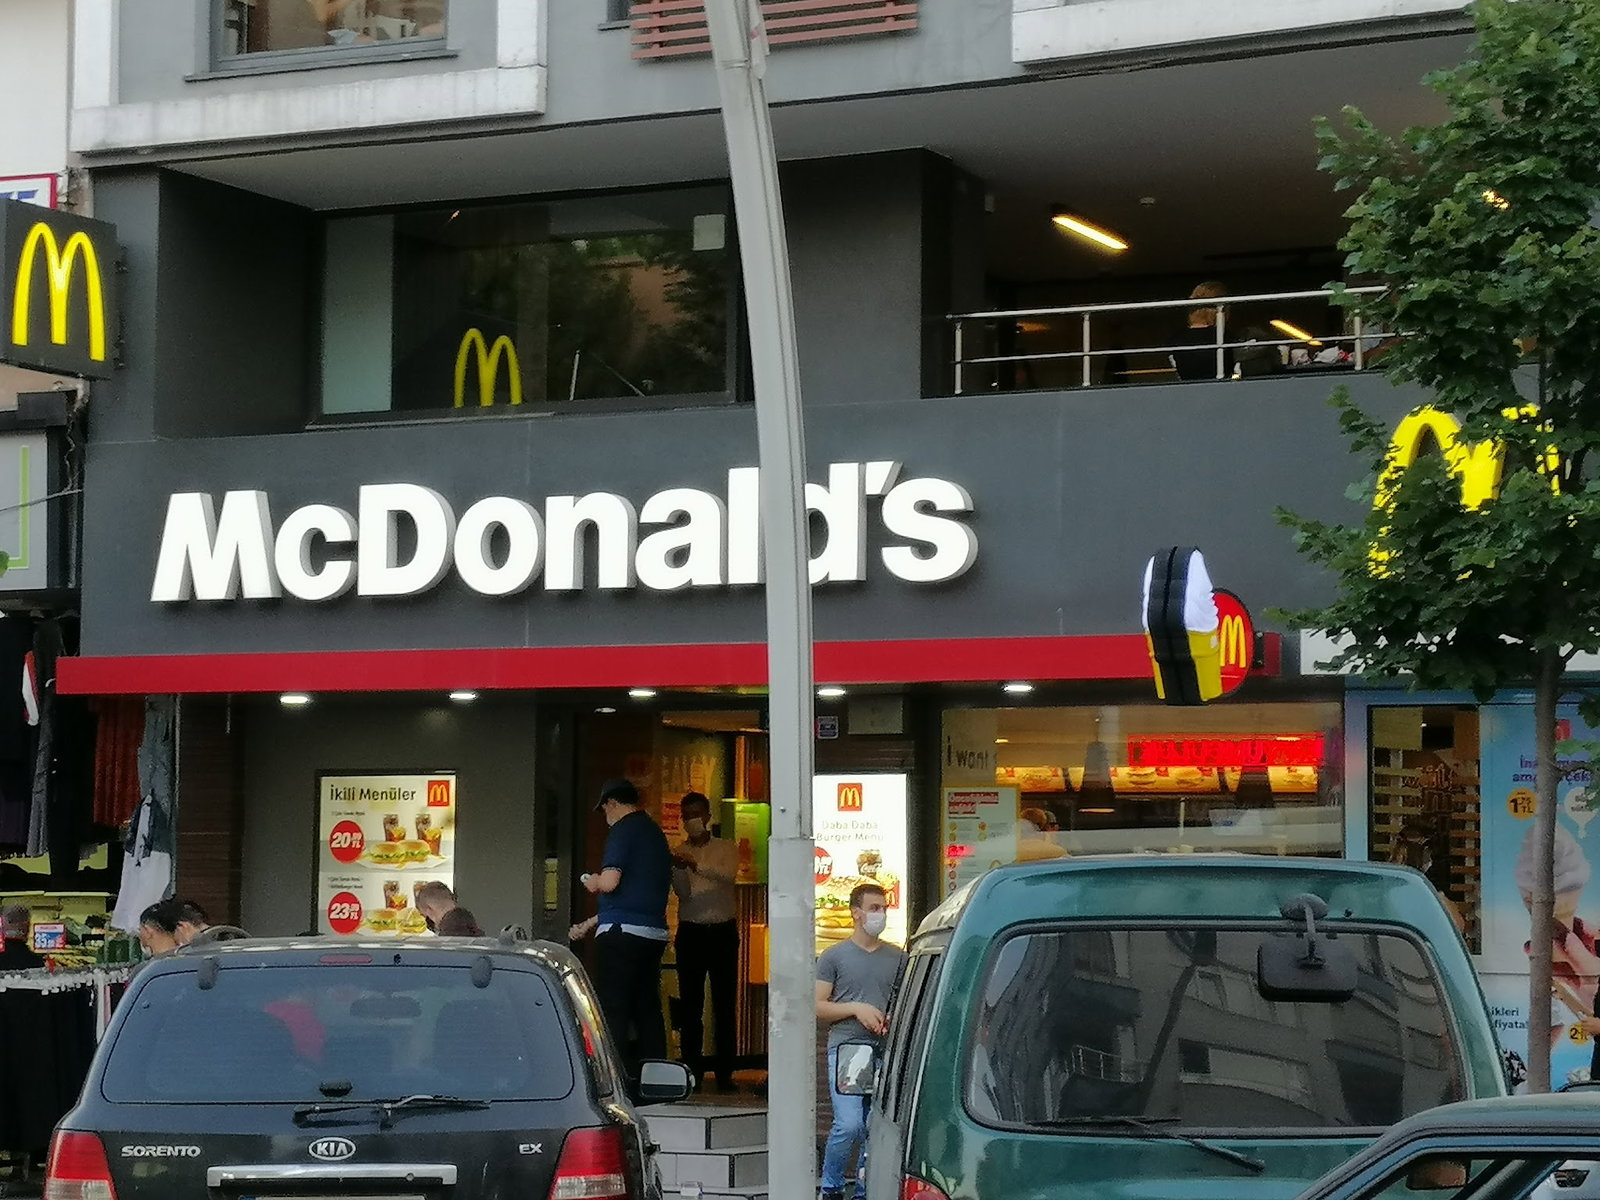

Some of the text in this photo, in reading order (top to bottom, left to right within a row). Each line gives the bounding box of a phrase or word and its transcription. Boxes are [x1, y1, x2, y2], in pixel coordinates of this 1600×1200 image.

[150, 460, 978, 601] McDonald's
[358, 787, 416, 801] Menüler
[1491, 1006, 1520, 1017] ikleri
[121, 1145, 201, 1157] SORENTO
[315, 1142, 349, 1156] KIA
[518, 1143, 543, 1155] EX
